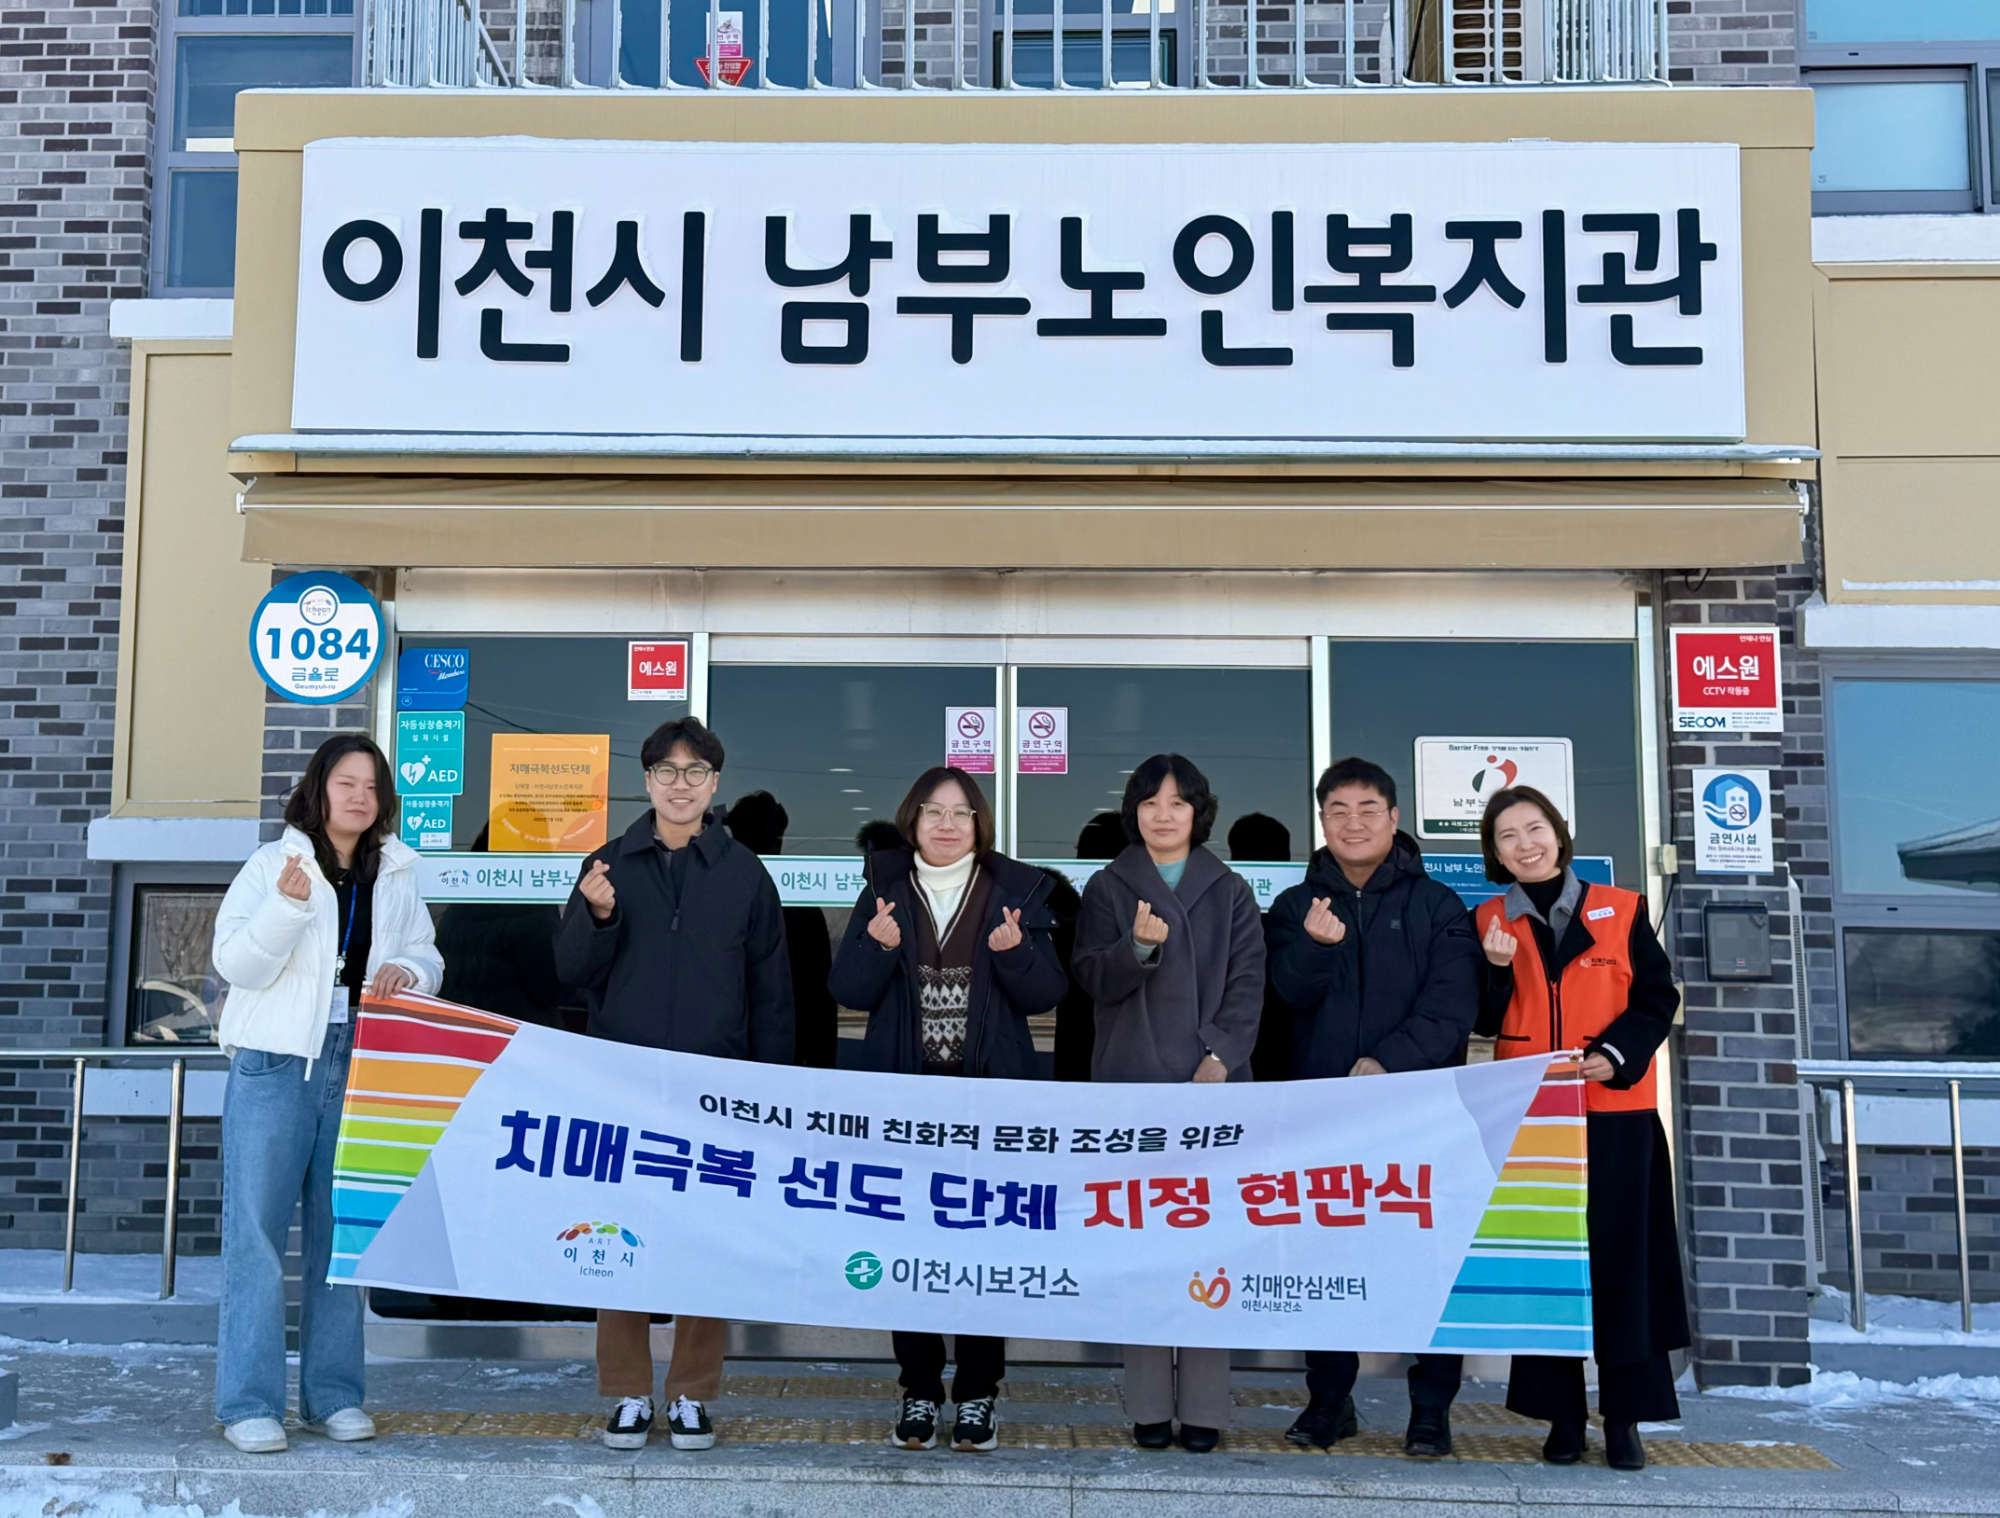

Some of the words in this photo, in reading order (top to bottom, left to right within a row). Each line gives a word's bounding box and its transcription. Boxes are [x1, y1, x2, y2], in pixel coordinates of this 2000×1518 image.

[322, 208, 705, 361] 이천시
[765, 208, 1717, 367] 남부노인복지관
[266, 628, 371, 660] 1084
[424, 654, 465, 668] CESCO
[639, 660, 677, 676] 에스원
[1693, 655, 1760, 680] 에스원
[292, 667, 339, 681] 금율로
[1703, 687, 1725, 695] CCTV
[400, 719, 461, 730] 자동심장충격기
[1679, 716, 1726, 728] SECOM
[427, 770, 458, 782] AED
[423, 819, 446, 829] AED
[1709, 832, 1757, 845] 금연시설
[1444, 862, 1462, 873] 남부
[476, 869, 523, 887] 이천시
[781, 872, 826, 890] 이천시
[699, 1094, 792, 1129] 이천시
[806, 1111, 869, 1139] 치매
[882, 1118, 980, 1150] 친화적
[993, 1126, 1059, 1153] 문화
[1070, 1127, 1168, 1153] 조성을
[1179, 1124, 1244, 1149] 위한
[495, 1109, 757, 1198] 치매극복
[778, 1157, 905, 1221] 선도
[929, 1171, 1057, 1230] 단체
[1084, 1177, 1211, 1229] 지정
[1237, 1163, 1433, 1229] 현판식
[579, 1266, 613, 1278] Icheon
[892, 1257, 1080, 1298] 이천시보건소
[1241, 1274, 1367, 1301] 치매안심센터
[1242, 1299, 1303, 1313] 이천시보건소
